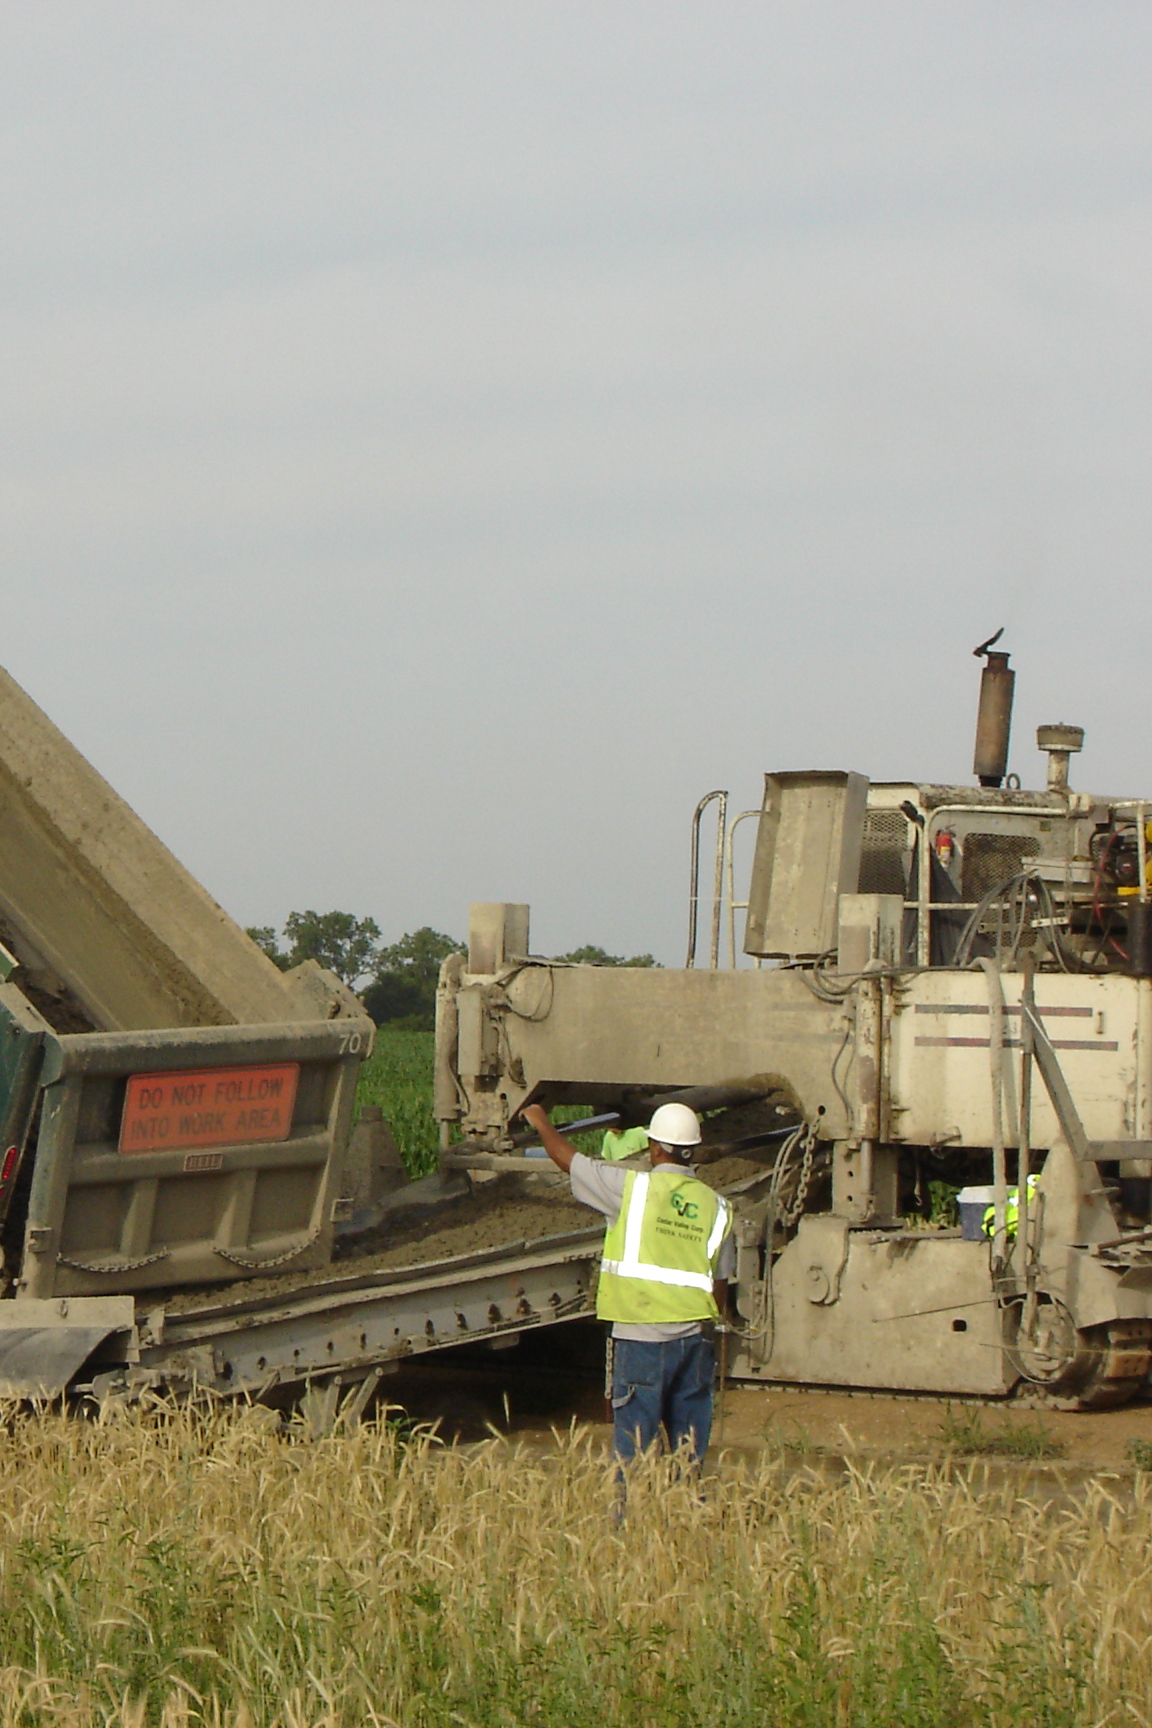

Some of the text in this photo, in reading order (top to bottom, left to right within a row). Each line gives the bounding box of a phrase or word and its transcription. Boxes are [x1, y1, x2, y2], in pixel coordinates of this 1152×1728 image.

[339, 1033, 361, 1054] 70
[139, 1077, 284, 1110] DO NOT FOLLOW
[131, 1107, 282, 1141] INTO WORK AREA
